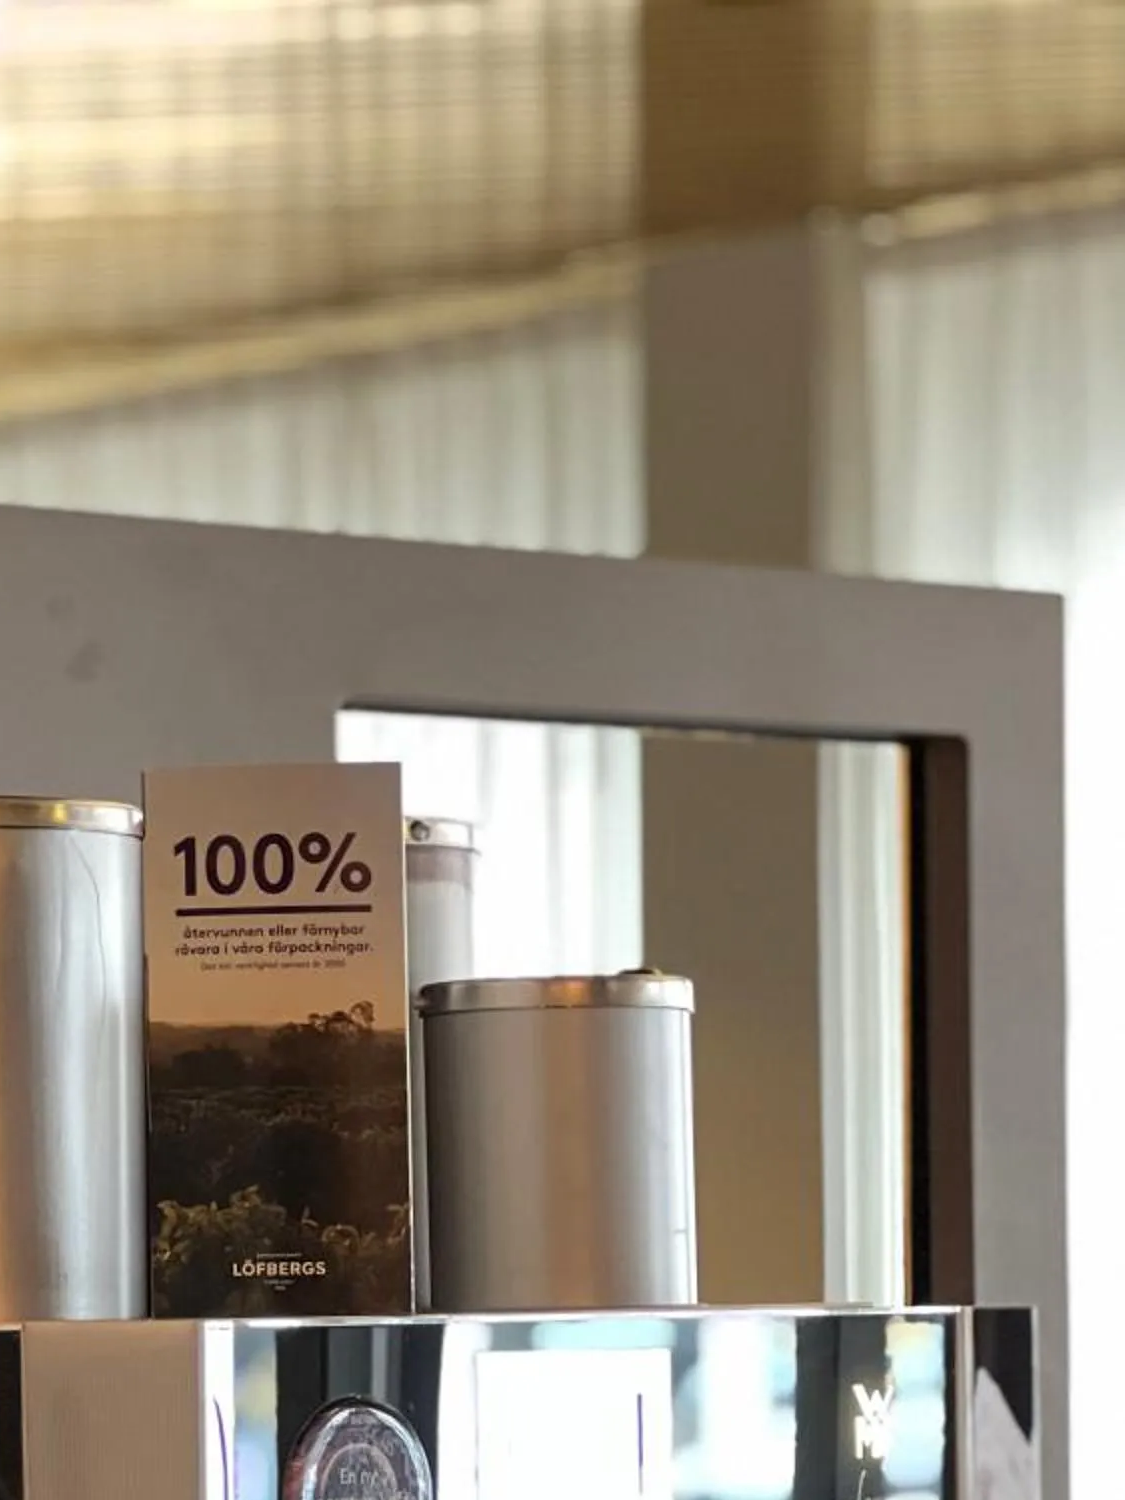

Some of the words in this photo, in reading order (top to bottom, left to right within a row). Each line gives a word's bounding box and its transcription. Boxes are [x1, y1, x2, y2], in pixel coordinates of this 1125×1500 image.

[173, 831, 372, 896] 100%
[183, 925, 264, 939] återvunnen
[268, 925, 297, 937] eller
[303, 923, 365, 939] förnybar
[176, 942, 220, 956] råvara
[232, 941, 264, 955] våra
[232, 1258, 327, 1278] LÖFBERGS
